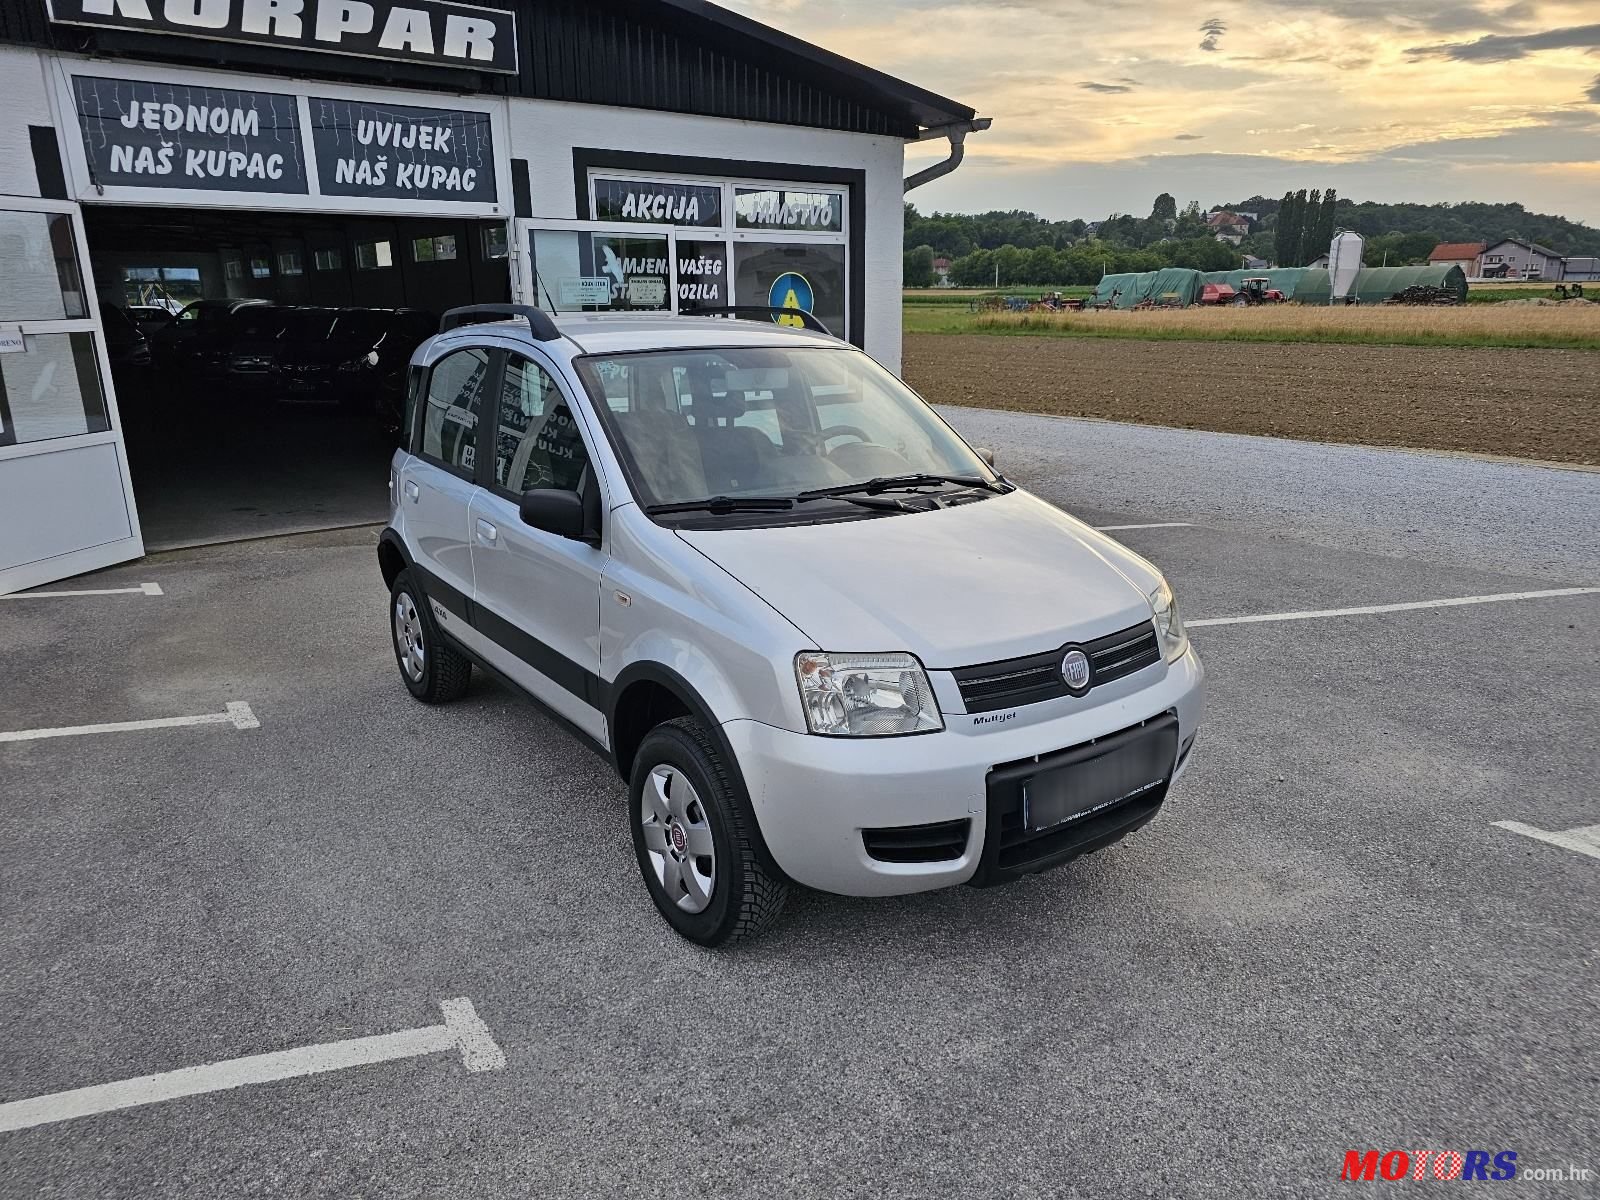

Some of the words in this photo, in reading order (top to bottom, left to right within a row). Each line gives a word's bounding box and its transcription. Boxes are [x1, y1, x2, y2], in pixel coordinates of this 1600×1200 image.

[120, 101, 259, 137] JEDNOM
[357, 119, 452, 154] UVIJEK
[110, 141, 174, 175] NAŠ
[185, 149, 283, 180] KUPAC
[335, 155, 388, 186] NAŠ
[396, 163, 477, 192] KUPAC
[621, 192, 699, 220] AKCIJA
[746, 200, 832, 226] JAMSTVO
[679, 255, 723, 275] VAŠEG
[677, 283, 719, 300] OZILA
[973, 711, 1017, 725] Multijet
